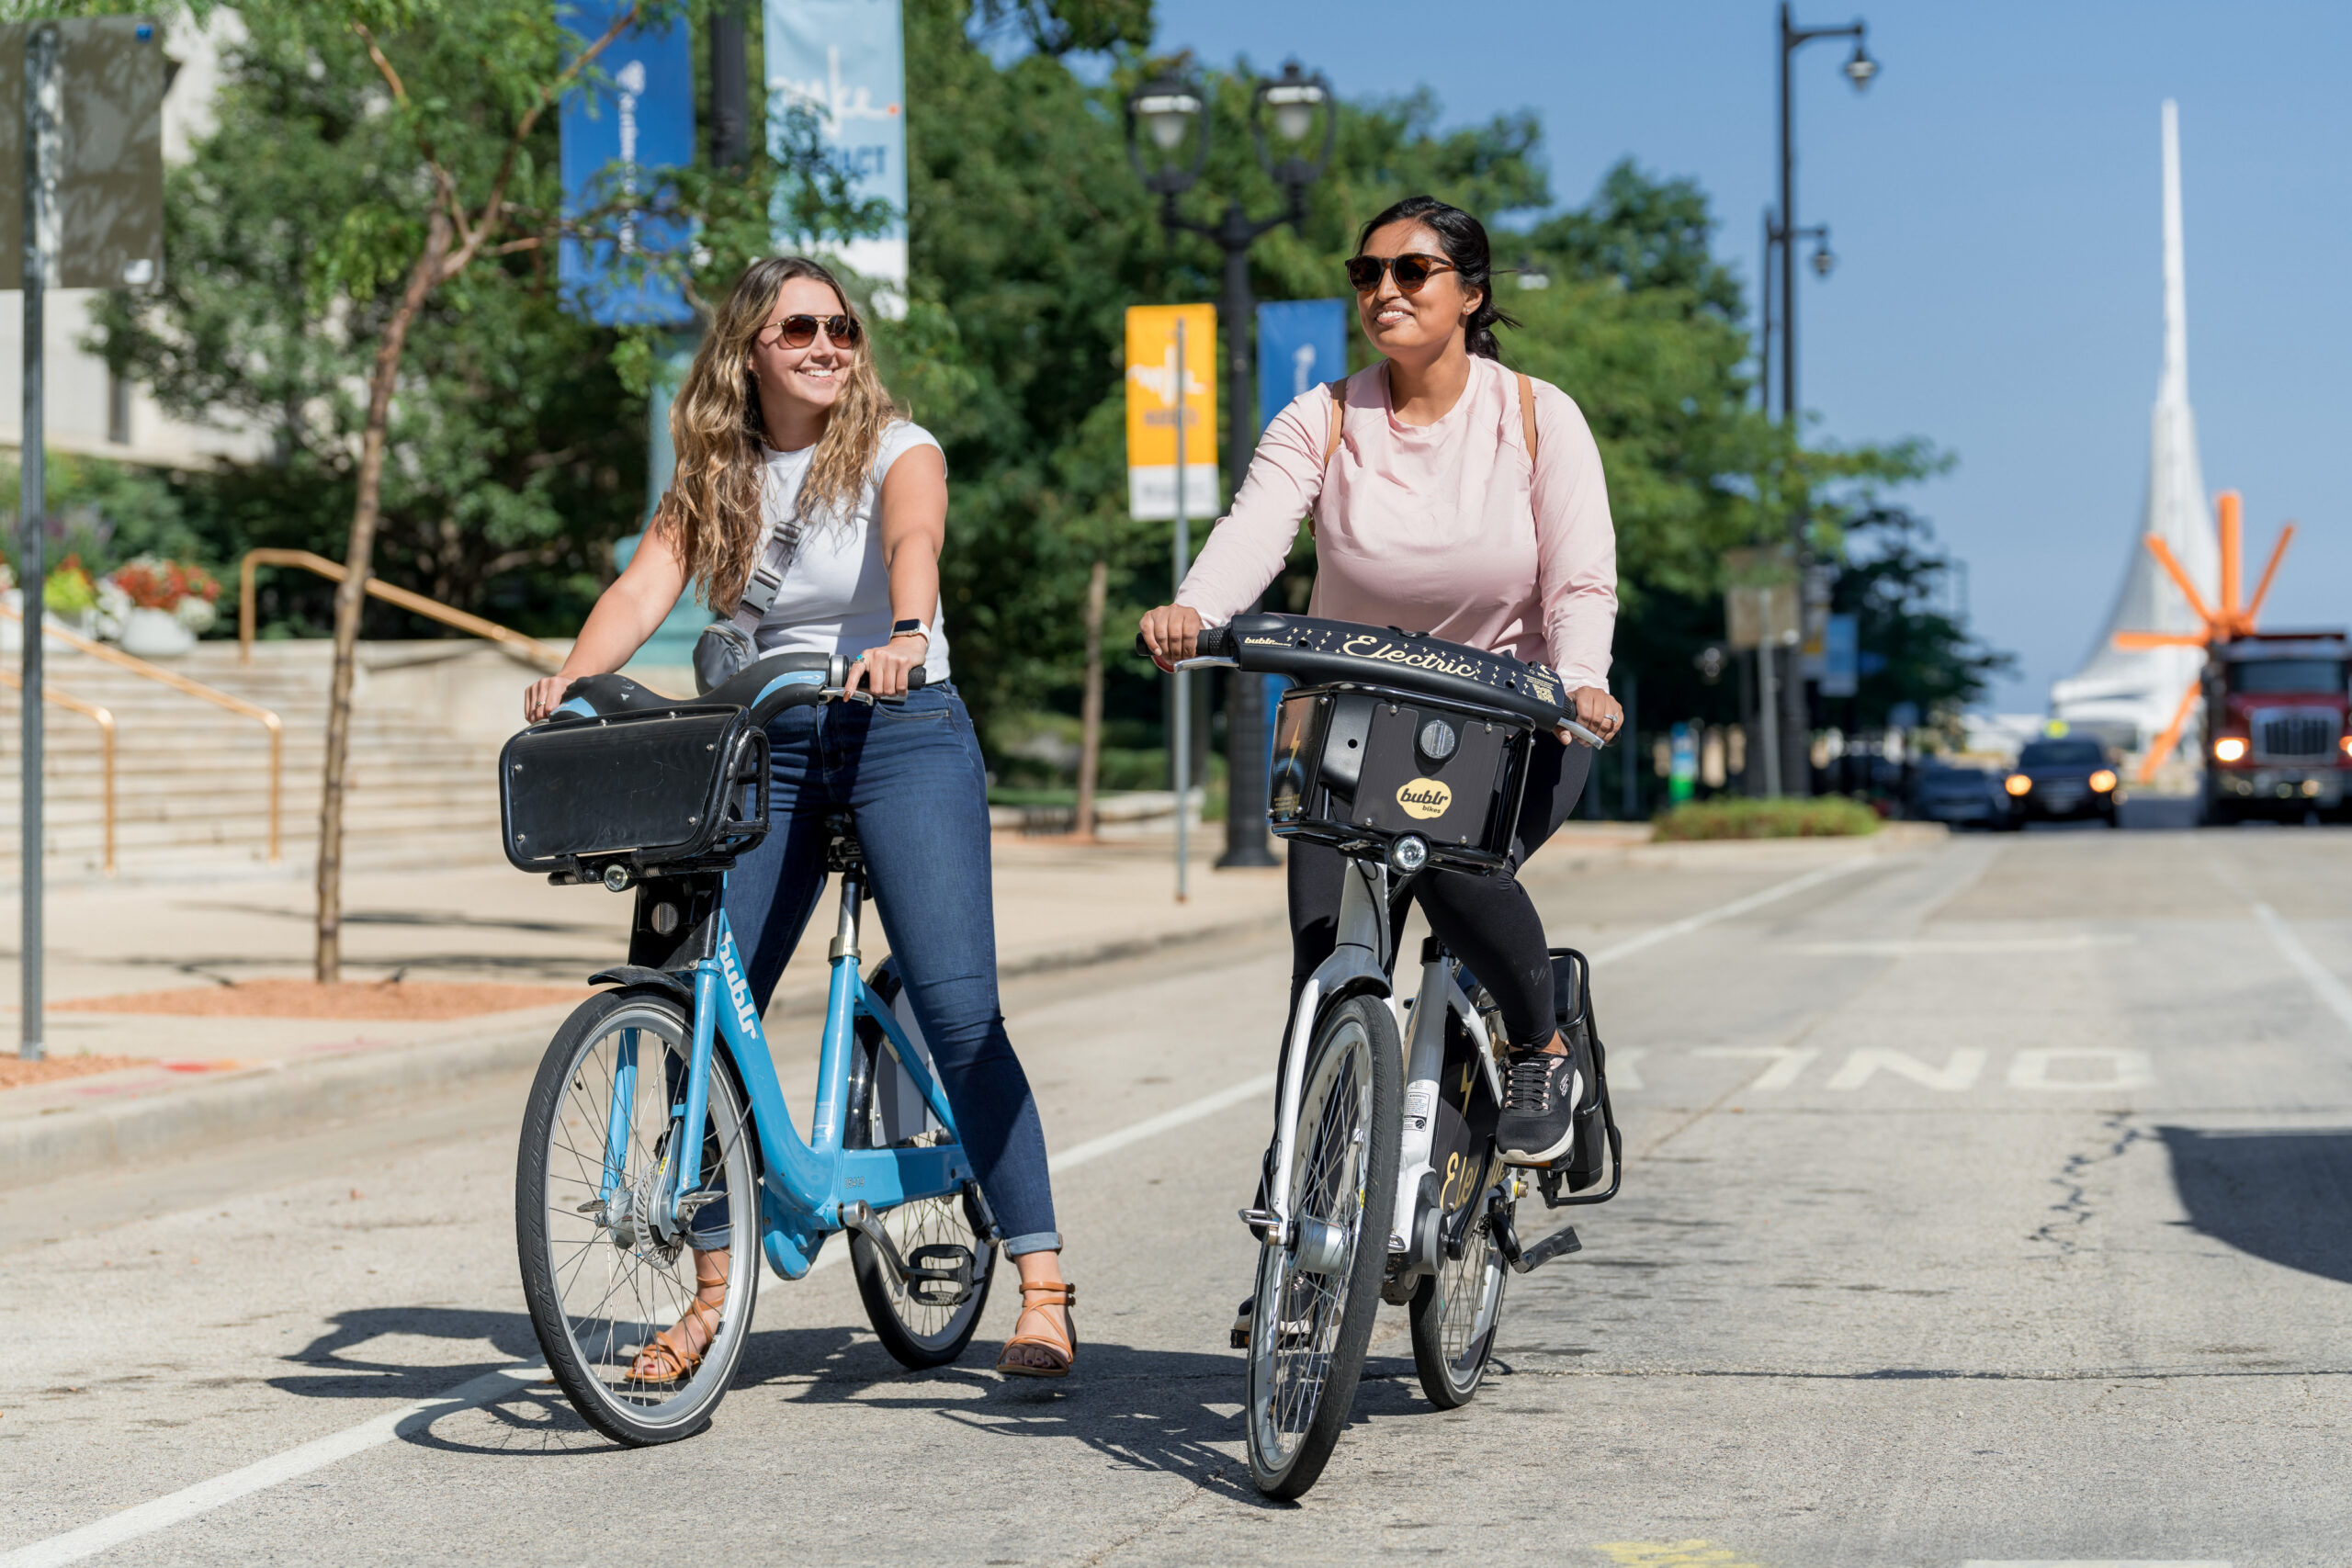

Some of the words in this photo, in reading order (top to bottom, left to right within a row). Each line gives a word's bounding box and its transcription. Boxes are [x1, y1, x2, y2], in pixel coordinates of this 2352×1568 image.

[1342, 635, 1476, 677] Electric
[1400, 787, 1449, 806] bublr
[1422, 805, 1442, 814] bikes
[718, 931, 757, 1040] bublr
